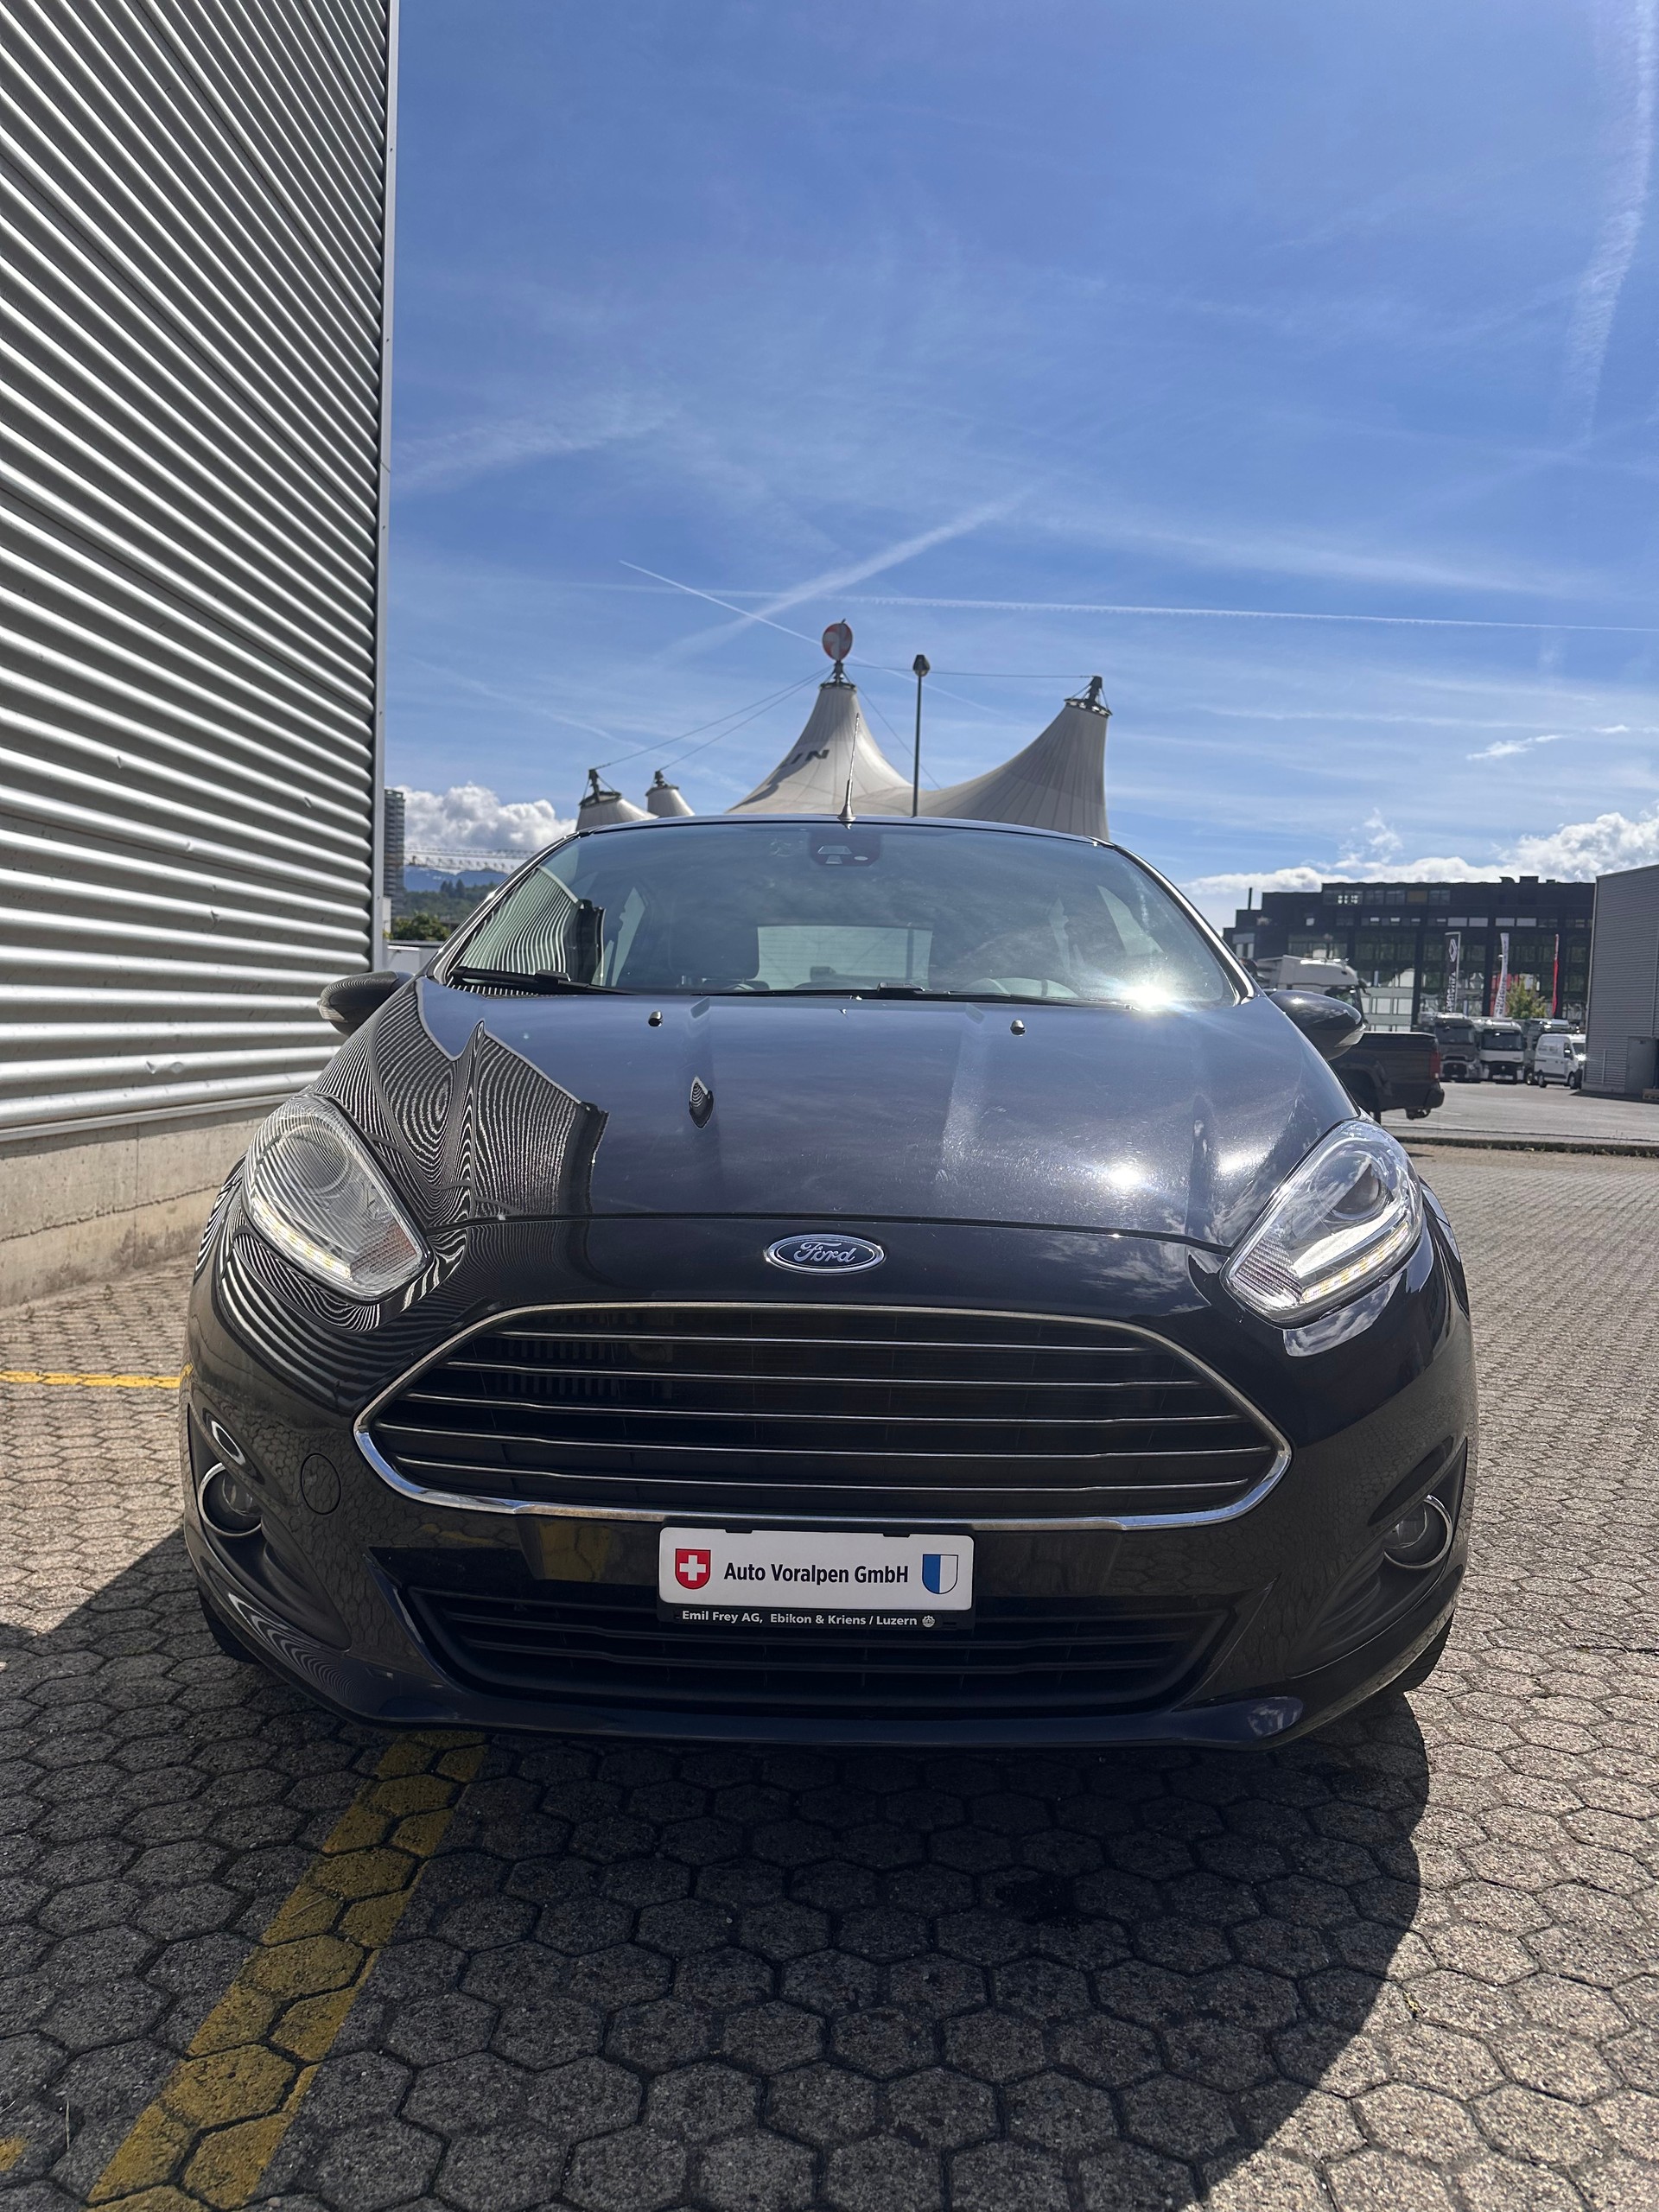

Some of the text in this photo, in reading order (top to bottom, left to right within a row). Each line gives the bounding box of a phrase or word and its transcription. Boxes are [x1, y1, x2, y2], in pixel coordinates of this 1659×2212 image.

[793, 1241, 857, 1263] Ford
[724, 1562, 908, 1586] Auto Voralpen GmbH
[682, 1610, 709, 1621] Emil
[712, 1611, 738, 1624] Frey
[741, 1612, 763, 1624] AG,
[770, 1613, 812, 1624] Ebikon
[815, 1614, 824, 1624] &
[828, 1614, 867, 1625] Kriens
[876, 1616, 918, 1626] Luzern
